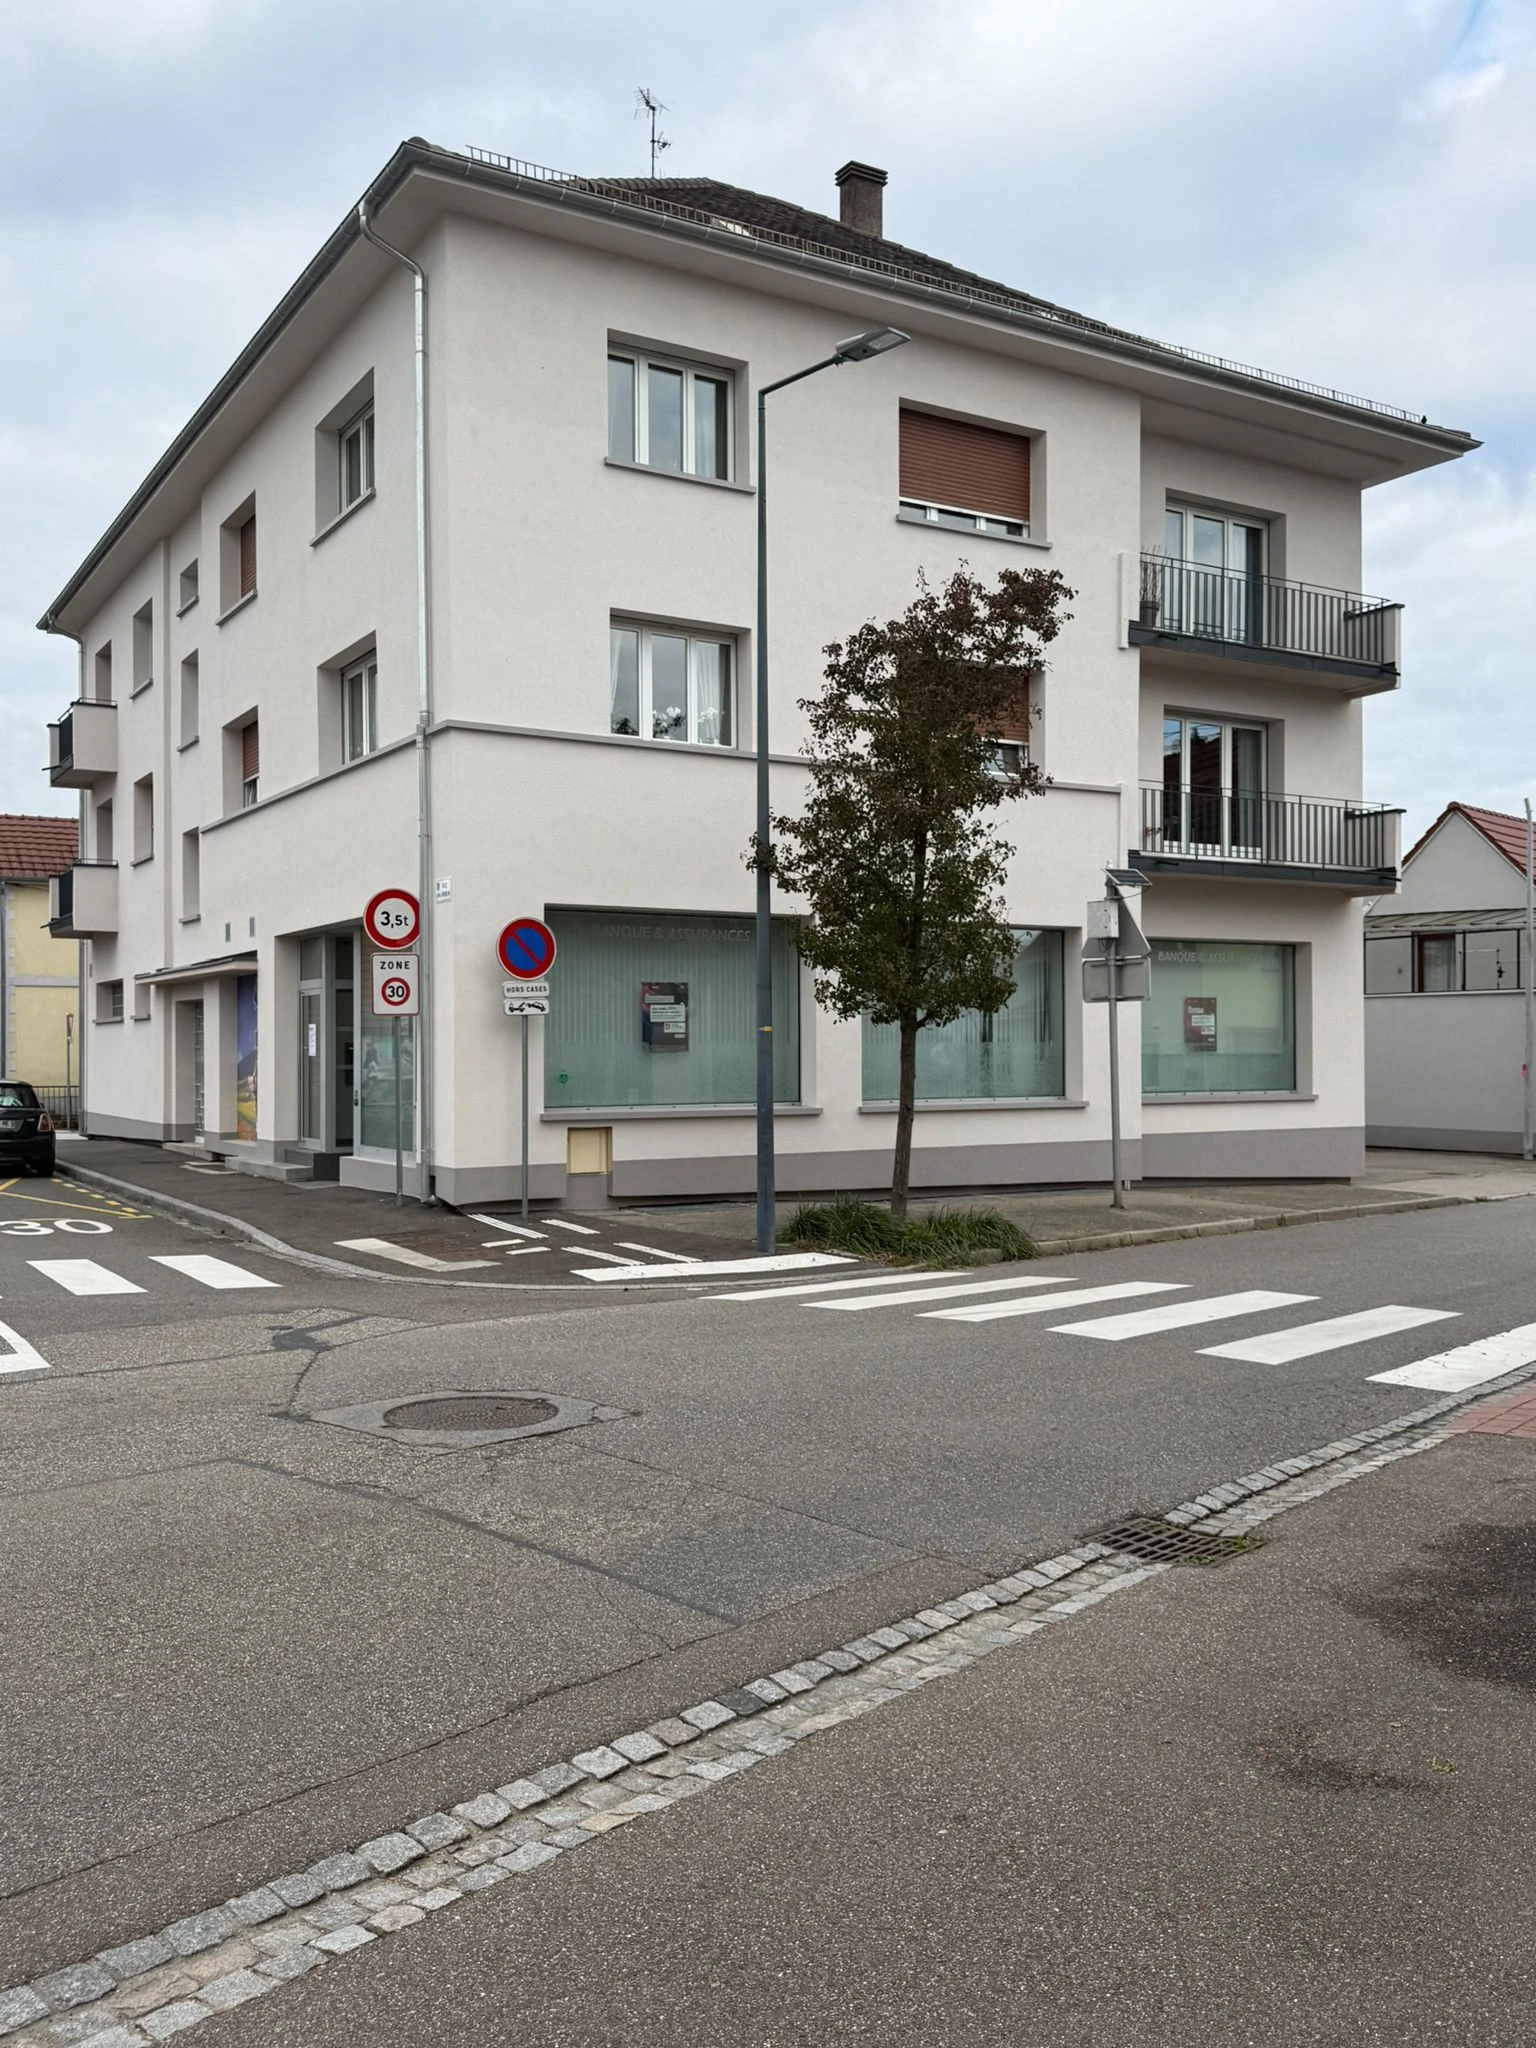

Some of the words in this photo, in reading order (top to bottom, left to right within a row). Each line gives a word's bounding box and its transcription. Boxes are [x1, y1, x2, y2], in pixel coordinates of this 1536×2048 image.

[591, 924, 651, 939] BANQUE
[653, 926, 664, 939] &
[667, 927, 752, 942] ASSURANCES
[1158, 951, 1197, 963] BANQUE
[380, 961, 411, 970] ZONE
[387, 986, 405, 998] 30
[506, 985, 524, 993] HORS
[526, 985, 548, 993] CASES
[0, 1219, 113, 1236] 30
